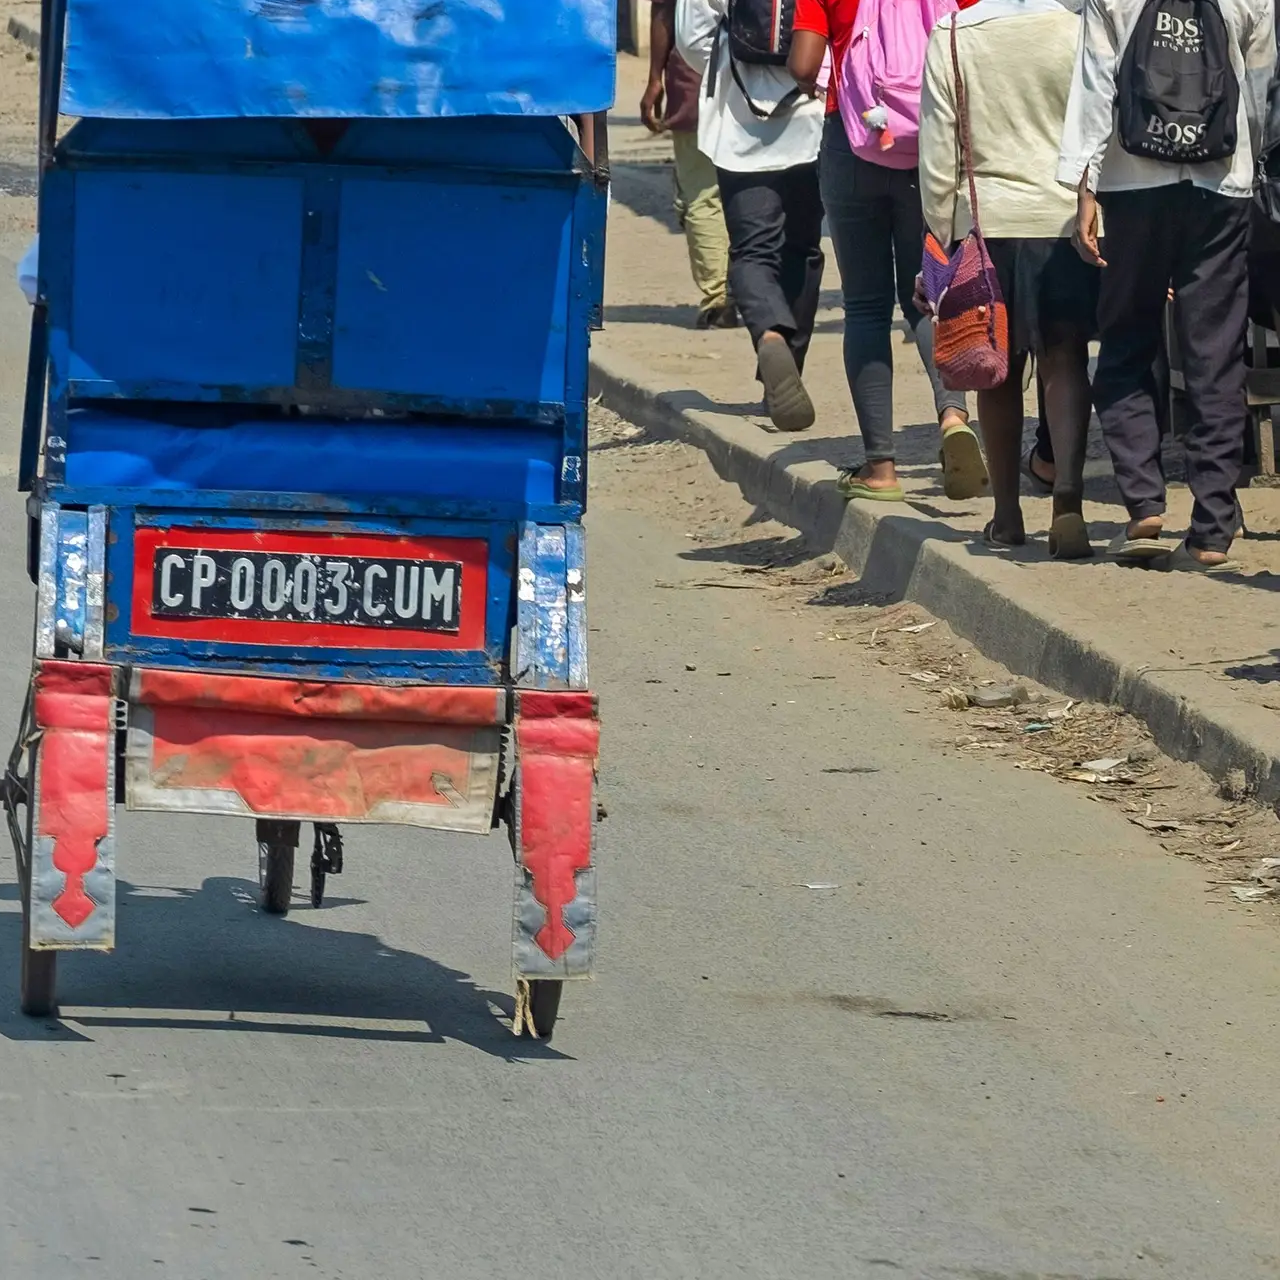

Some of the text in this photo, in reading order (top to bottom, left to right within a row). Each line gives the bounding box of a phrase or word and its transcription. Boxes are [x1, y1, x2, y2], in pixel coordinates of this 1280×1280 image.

[160, 553, 456, 621] CP 0003 CUM
